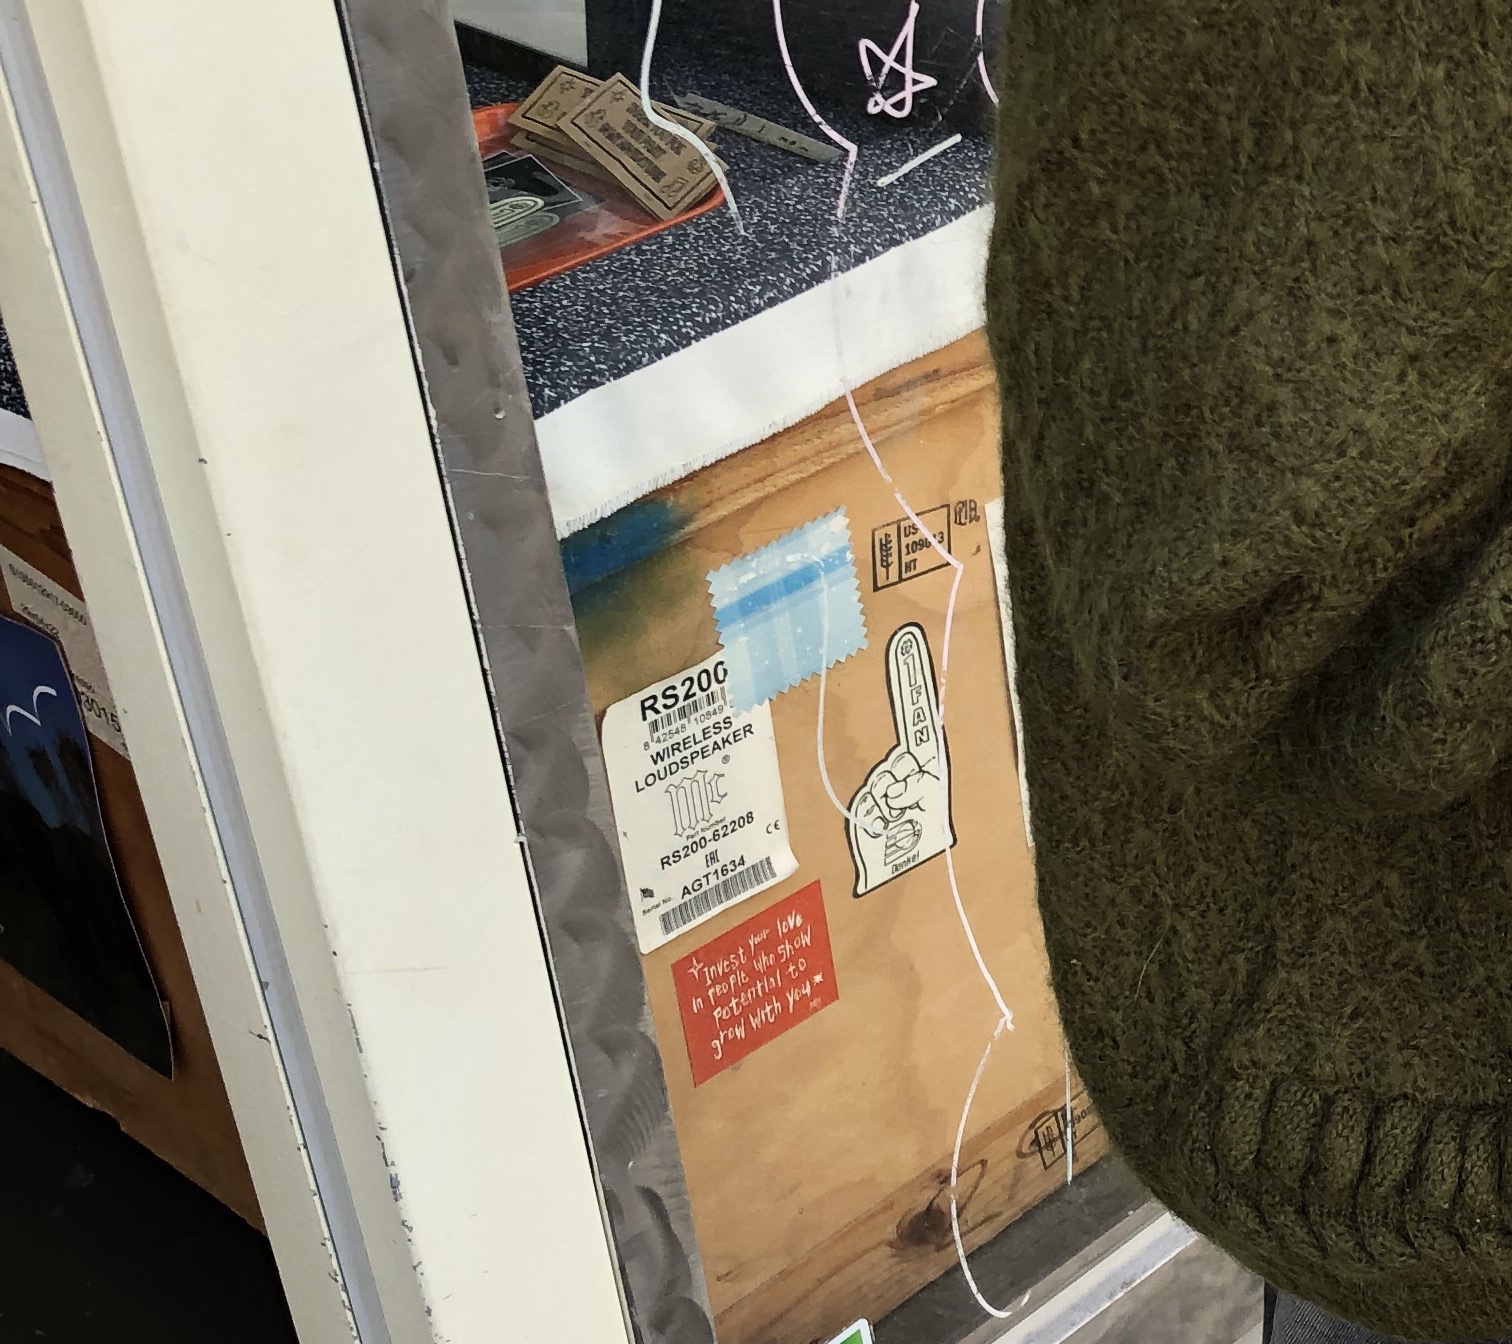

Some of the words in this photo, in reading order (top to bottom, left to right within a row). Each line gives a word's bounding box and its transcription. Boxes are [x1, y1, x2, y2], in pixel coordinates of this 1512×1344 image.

[904, 558, 918, 574] HT
[640, 660, 728, 722] RS200
[635, 723, 754, 793] LOUDSPEAKER
[650, 716, 733, 766] WIRELESS
[660, 811, 755, 870] RS200-62208
[681, 855, 746, 899] AGT1634
[703, 947, 747, 986] Invest
[777, 909, 803, 938] love
[708, 970, 749, 1006] people
[712, 968, 782, 1029] potential
[785, 957, 807, 979] to
[711, 1018, 746, 1060] grow
[785, 980, 811, 1014] you
